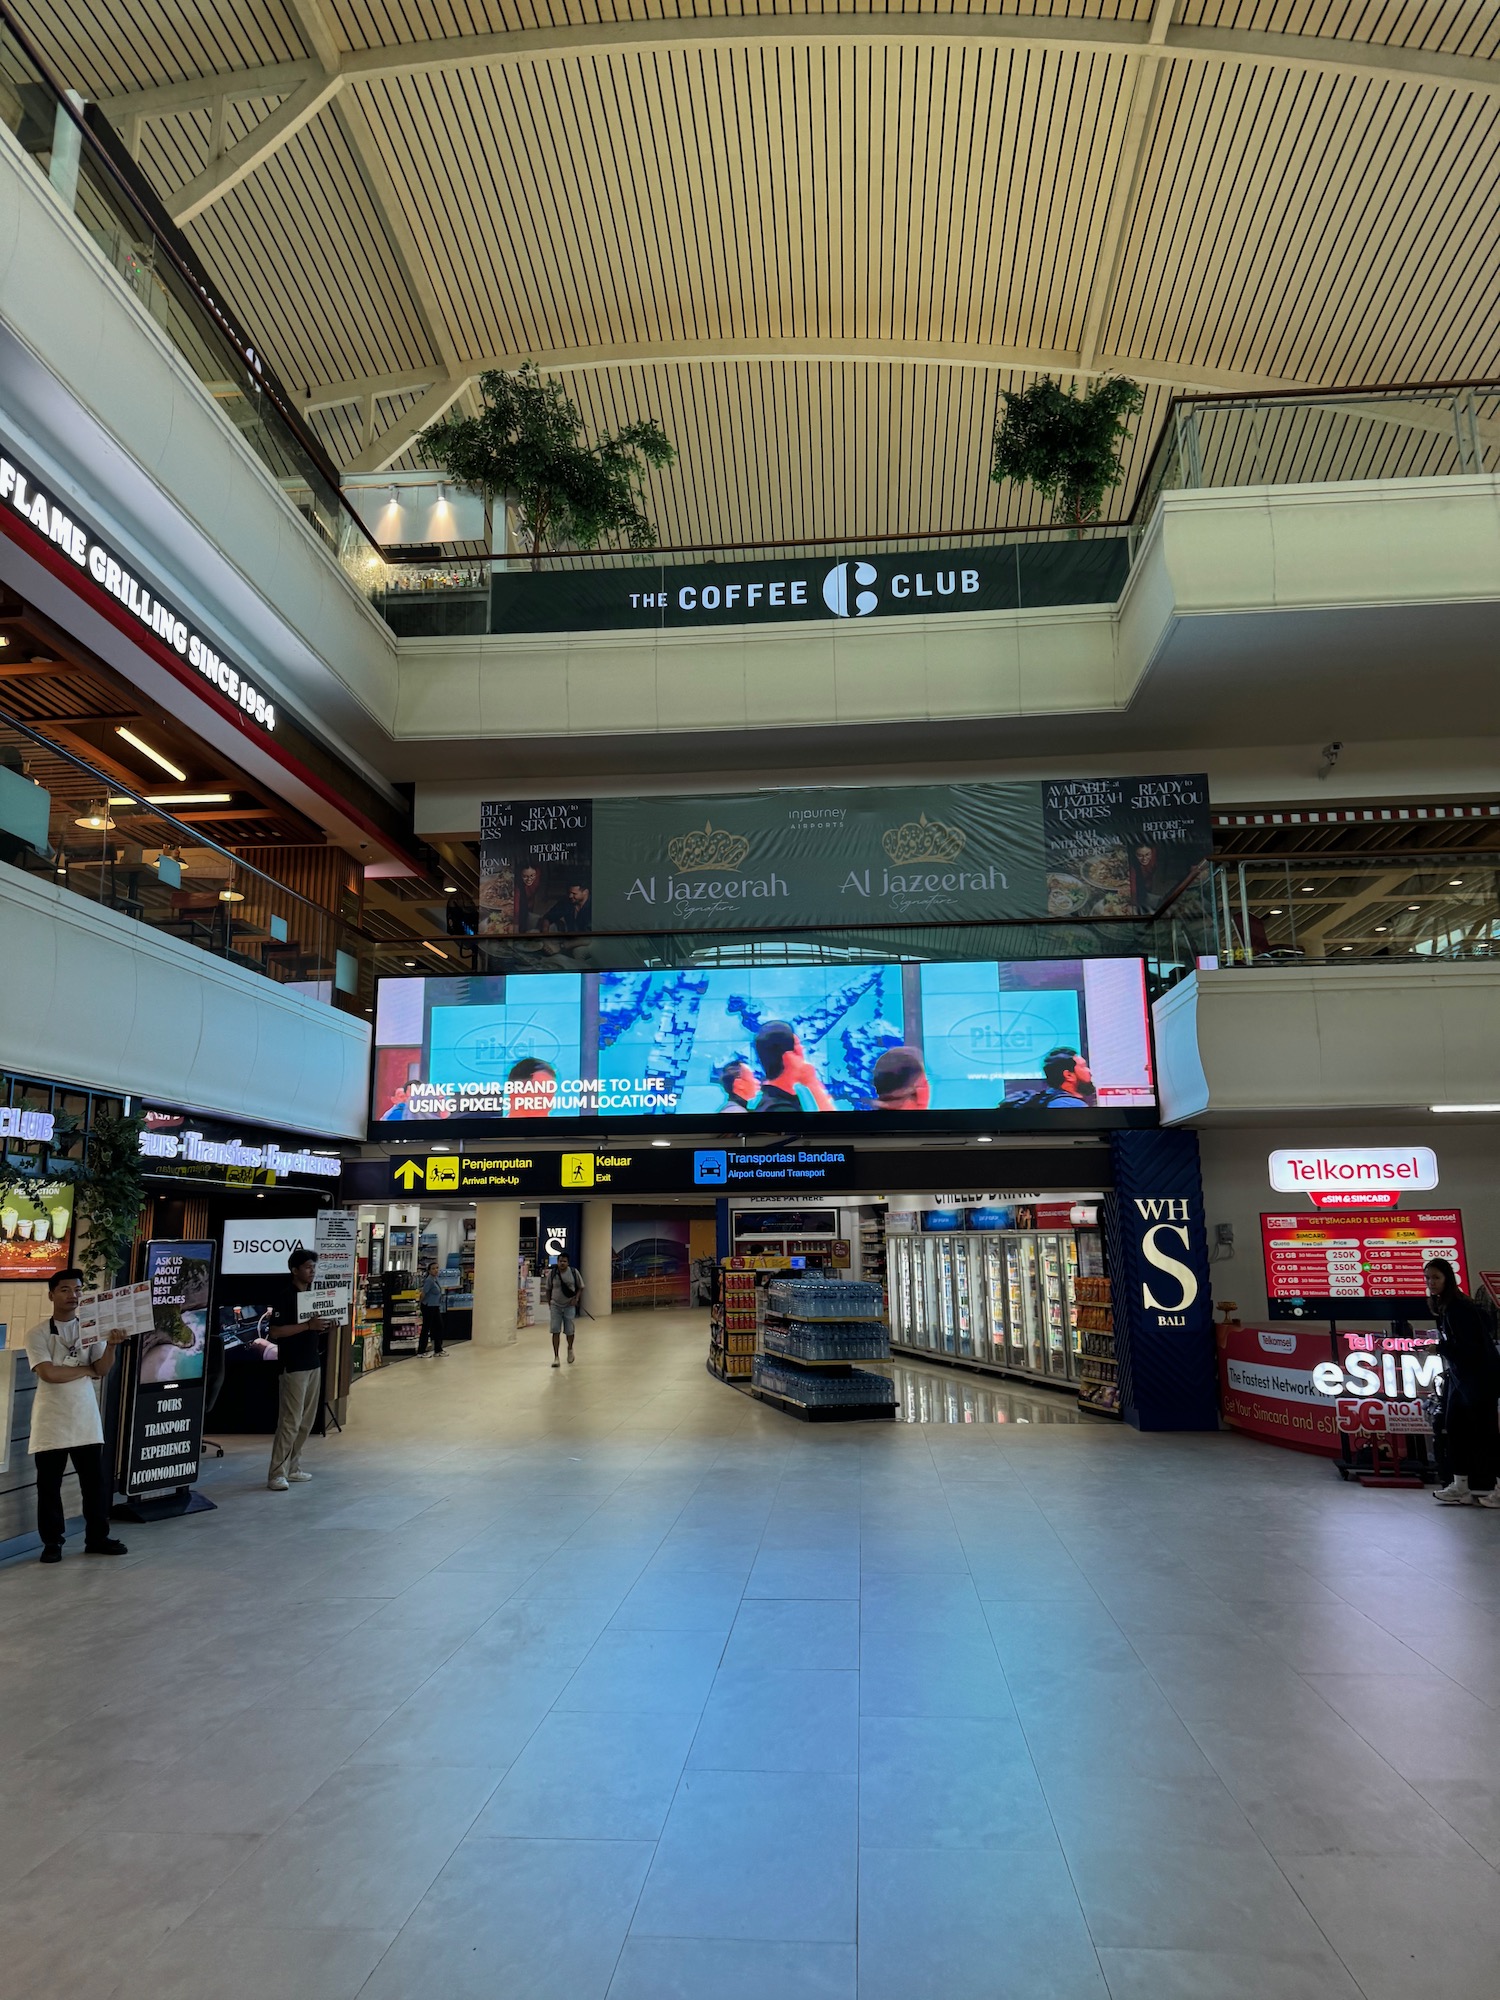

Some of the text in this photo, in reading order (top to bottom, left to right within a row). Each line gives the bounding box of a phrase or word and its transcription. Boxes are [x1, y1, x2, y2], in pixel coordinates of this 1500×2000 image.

[0, 458, 276, 731] FLAME GRILLING SINCE 1954
[629, 570, 980, 610] THE COFFEE CLUB
[1048, 781, 1110, 797] AVAILABLE
[1139, 781, 1183, 796] READY
[1046, 792, 1123, 809] AL JAZEERAH
[1131, 792, 1203, 809] SERVE YOU
[530, 806, 570, 819] READY
[788, 808, 847, 822] injourney
[1059, 806, 1111, 821] EXPRESS
[521, 816, 587, 832] SERVE YOU
[1143, 820, 1181, 832] BEFORE
[530, 843, 565, 853] BEFORE
[623, 873, 790, 904] Al jazeerah
[838, 866, 1010, 897] Al jazeerah
[673, 901, 740, 920] Signature
[889, 893, 958, 913] Signature
[970, 1026, 1033, 1048] Pixel
[475, 1036, 535, 1060] Pixel
[410, 1078, 664, 1097] MAKE YOUR BRAND COME TO LIFE
[409, 1094, 677, 1113] USING PIXEL'S PREMIUM LOCATIONS
[0, 1107, 55, 1141] CLUB
[266, 1144, 342, 1177] Experiences
[462, 1158, 532, 1170] Penjemputan
[596, 1156, 631, 1167] Keluar
[798, 1152, 845, 1163] Bandara
[728, 1169, 825, 1179] Airport Ground Transport
[1288, 1157, 1419, 1181] Telkomsel
[462, 1175, 519, 1186] Arrival Pick-Up
[596, 1174, 611, 1183] Exit
[1321, 1194, 1390, 1204] eSIM & SIMCARD
[1134, 1199, 1190, 1220] WH
[1326, 1217, 1362, 1225] SIMCARD
[1417, 1214, 1456, 1222] Telkomsel
[546, 1228, 567, 1237] WH
[233, 1239, 304, 1254] DISCOVA
[155, 1256, 183, 1266] ASK US
[1142, 1224, 1198, 1311] S
[154, 1266, 181, 1275] ABOUT
[154, 1276, 177, 1285] BALI'S
[313, 1280, 352, 1291] TRANSPORT
[153, 1286, 171, 1295] BEST
[1336, 1288, 1360, 1296] 600K
[152, 1295, 186, 1305] BEACHES
[312, 1300, 334, 1310] OFFICIAL
[320, 1307, 347, 1318] TRANSPORT
[1157, 1316, 1185, 1326] BALI
[1262, 1335, 1292, 1347] Telkomsel
[1229, 1367, 1316, 1397] The Fastest Network
[1312, 1352, 1443, 1399] eSIM
[157, 1398, 182, 1413] TOURS
[1388, 1401, 1422, 1416] NO.1
[1236, 1400, 1252, 1417] Your
[1253, 1403, 1289, 1426] Simcard
[1292, 1412, 1313, 1431] and
[1338, 1400, 1387, 1431] 5G
[145, 1419, 191, 1438] TRANSPORT
[140, 1440, 191, 1461] EXPERIENCES
[130, 1461, 197, 1486] ACCOMMODATION
